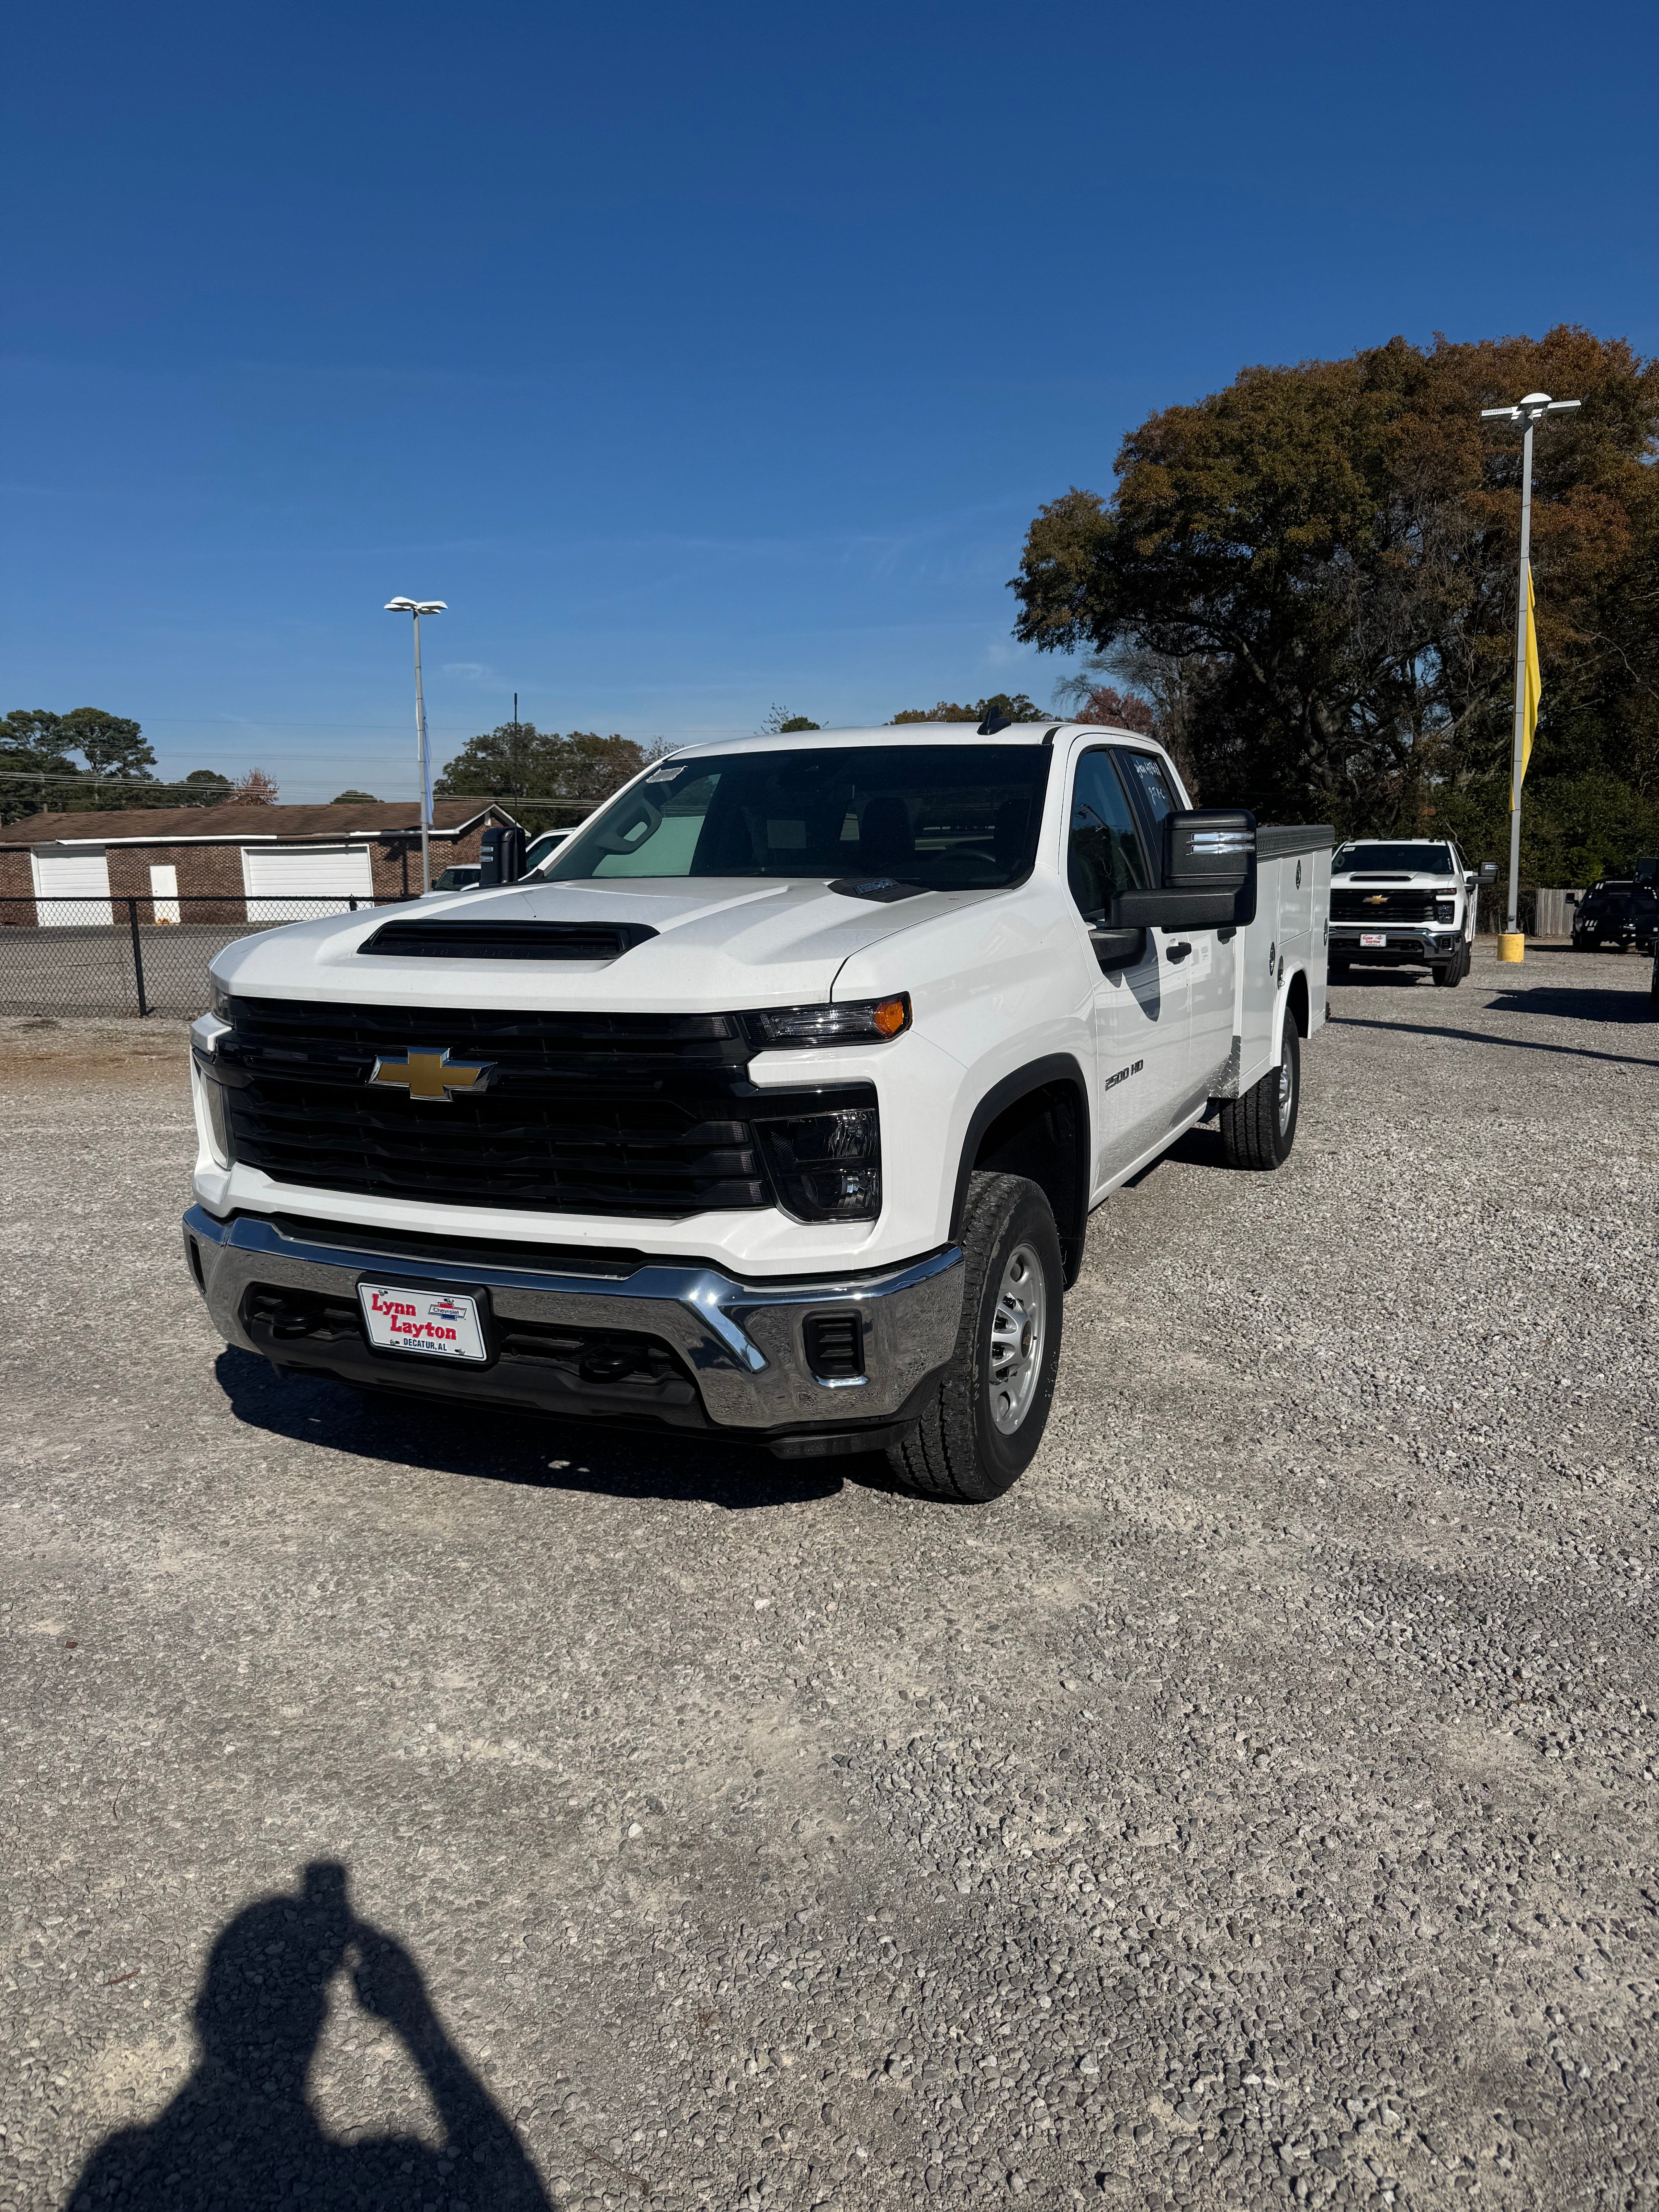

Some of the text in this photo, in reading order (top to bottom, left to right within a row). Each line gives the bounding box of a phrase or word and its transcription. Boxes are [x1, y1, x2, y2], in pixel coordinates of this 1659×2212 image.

[1105, 1059, 1143, 1092] 2500 HD
[372, 1293, 416, 1316] Lynn
[390, 1315, 457, 1340] Layton
[404, 1338, 437, 1351] DECATUR,
